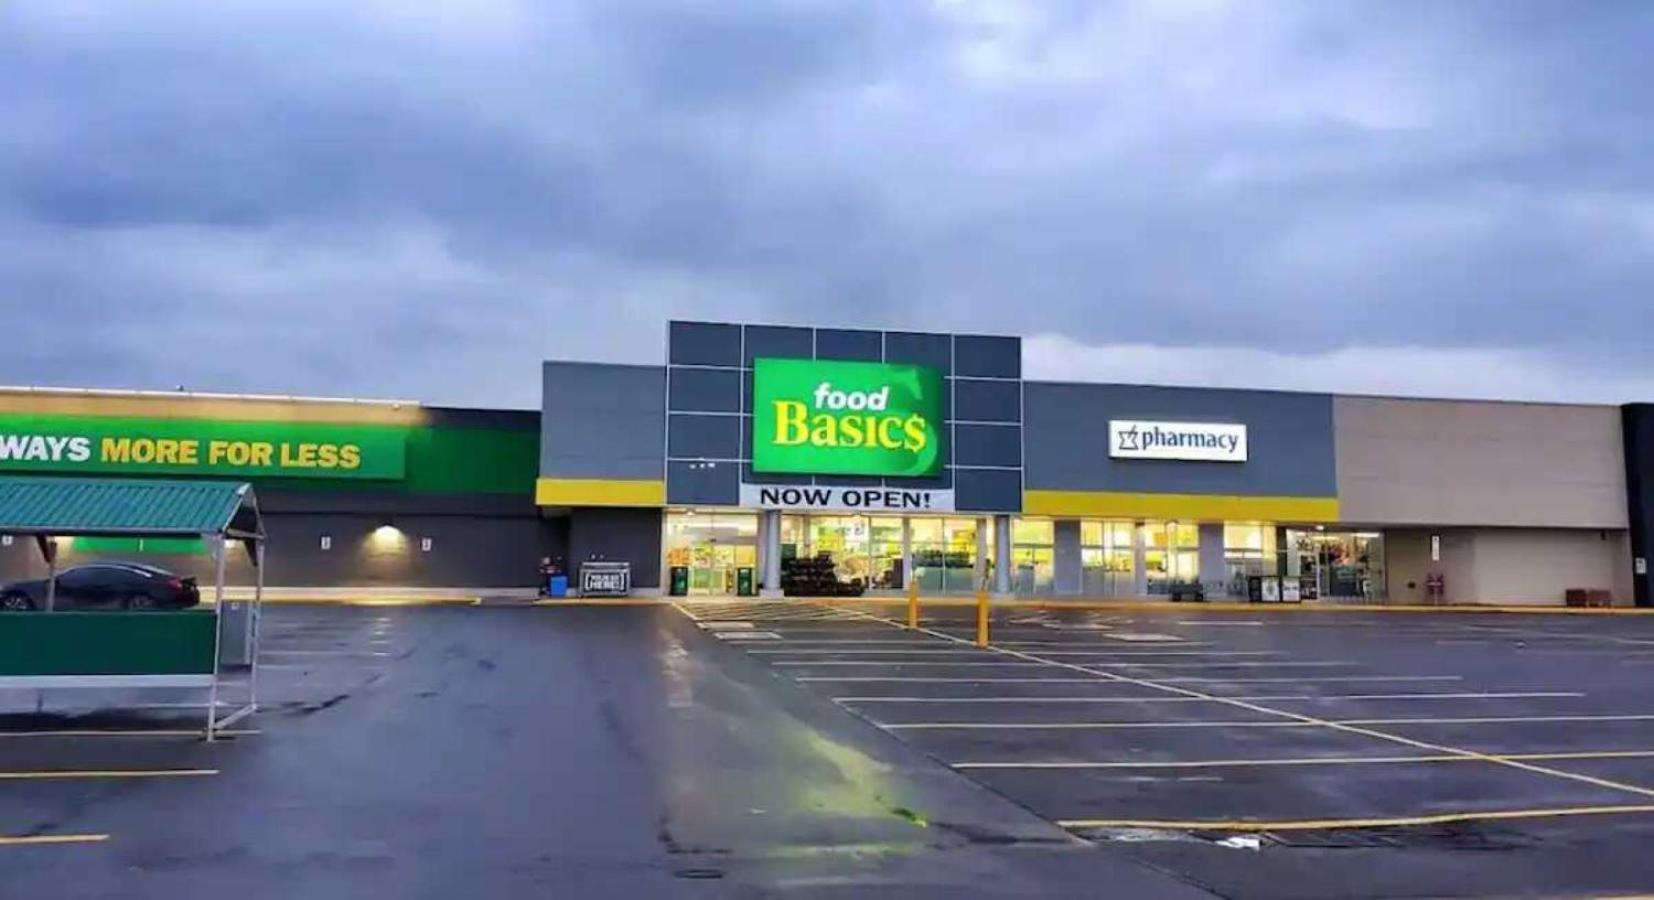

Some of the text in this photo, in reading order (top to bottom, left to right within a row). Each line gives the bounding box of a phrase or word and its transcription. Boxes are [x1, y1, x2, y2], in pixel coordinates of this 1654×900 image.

[813, 382, 890, 410] food
[101, 438, 199, 464] MORE
[209, 442, 274, 466] FOR
[280, 444, 360, 469] LESS
[1142, 427, 1239, 453] pharmacy
[760, 488, 931, 508] NOW OPEN!
